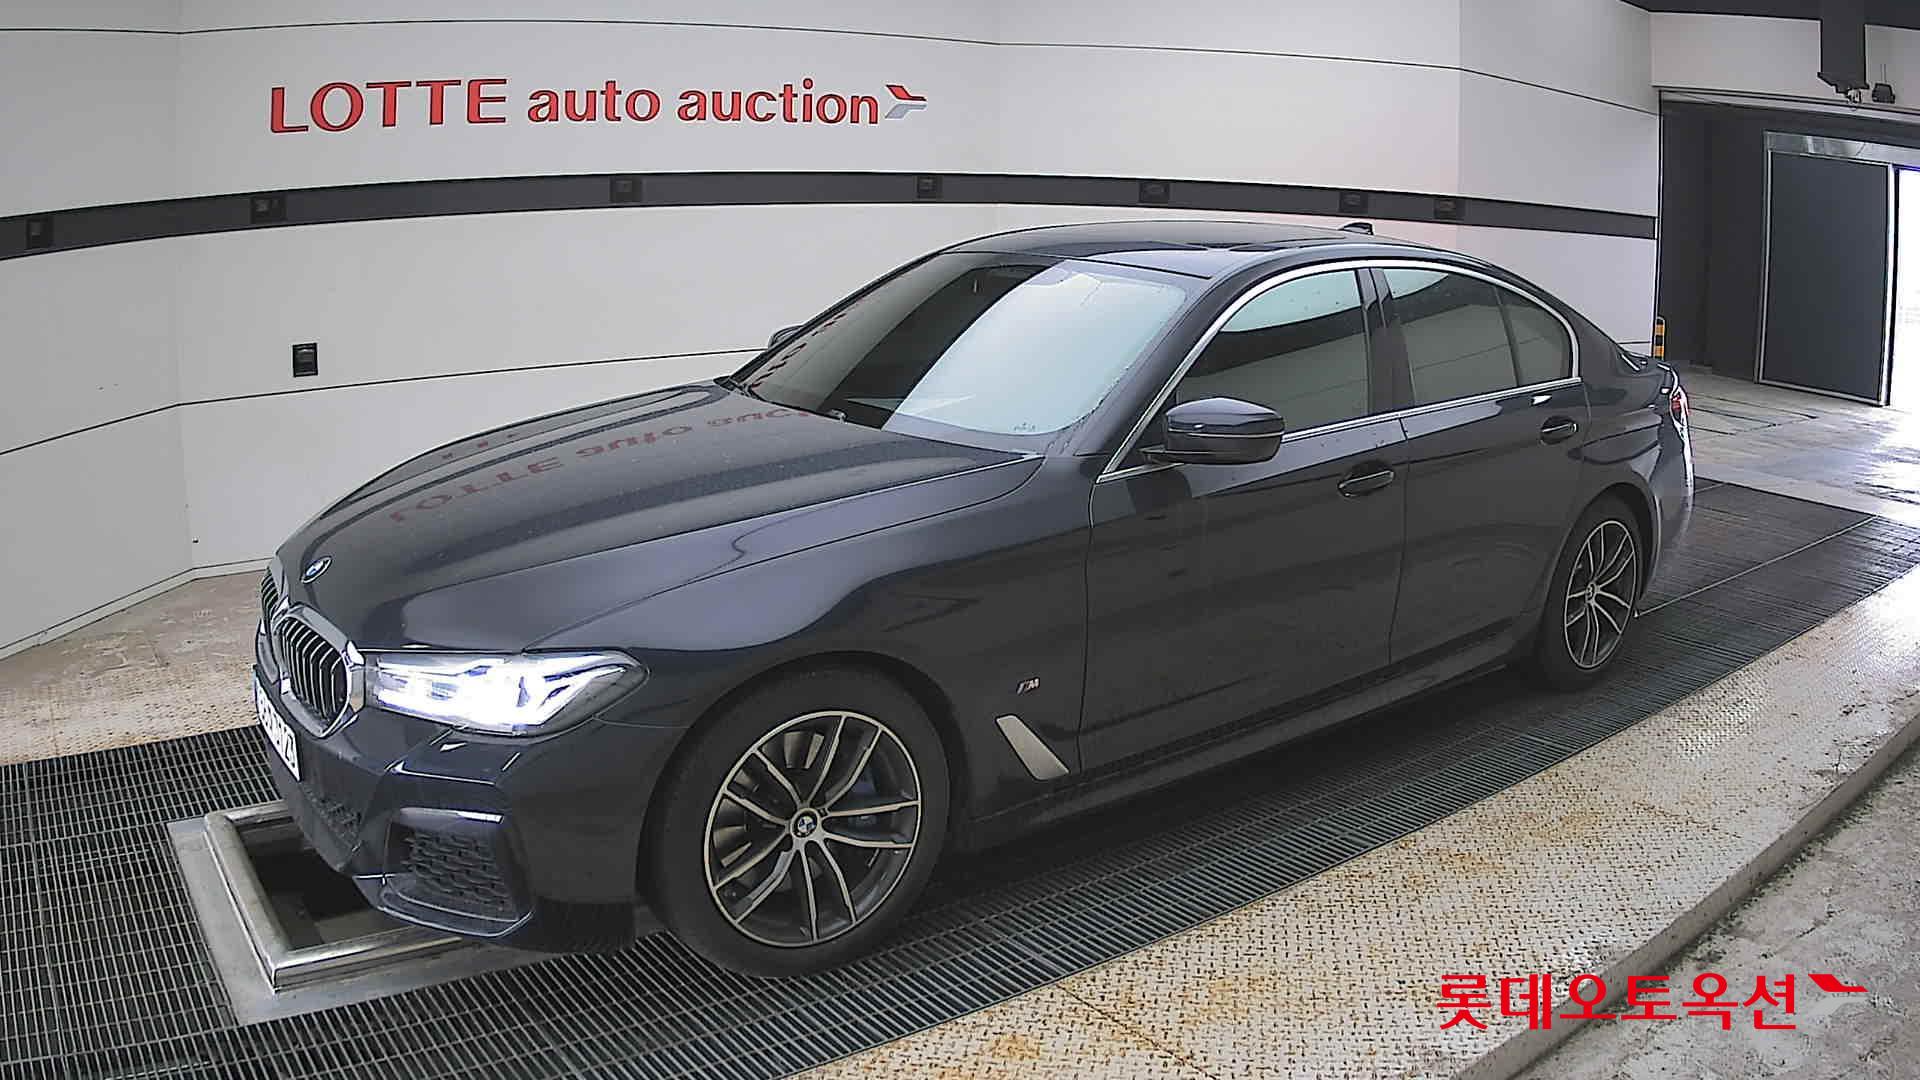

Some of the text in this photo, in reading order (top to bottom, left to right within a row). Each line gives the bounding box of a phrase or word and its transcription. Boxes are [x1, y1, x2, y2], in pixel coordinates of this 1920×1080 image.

[270, 78, 879, 134] LOTTE auto auction
